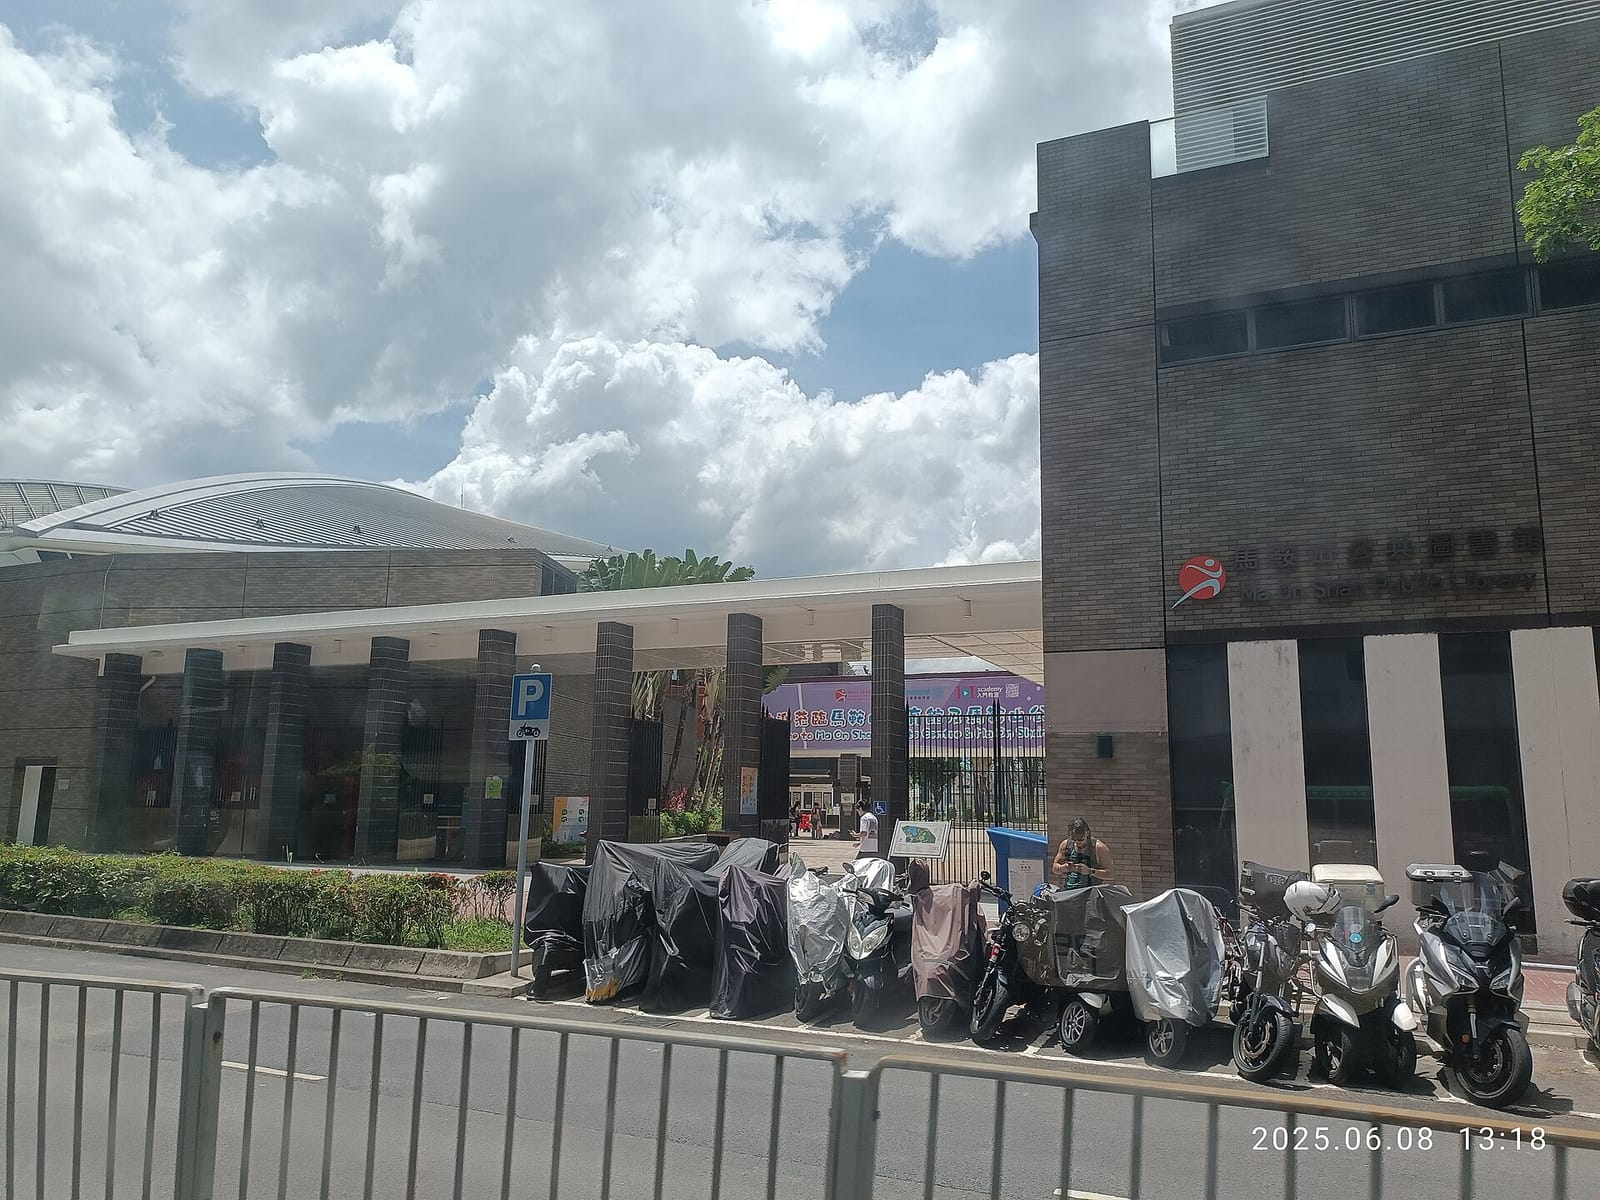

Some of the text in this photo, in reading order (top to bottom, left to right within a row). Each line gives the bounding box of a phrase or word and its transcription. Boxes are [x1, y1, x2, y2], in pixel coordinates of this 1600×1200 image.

[517, 679, 544, 716] P
[801, 731, 814, 741] to
[815, 729, 832, 741] Ma
[833, 729, 850, 741] On
[851, 728, 872, 741] Sha
